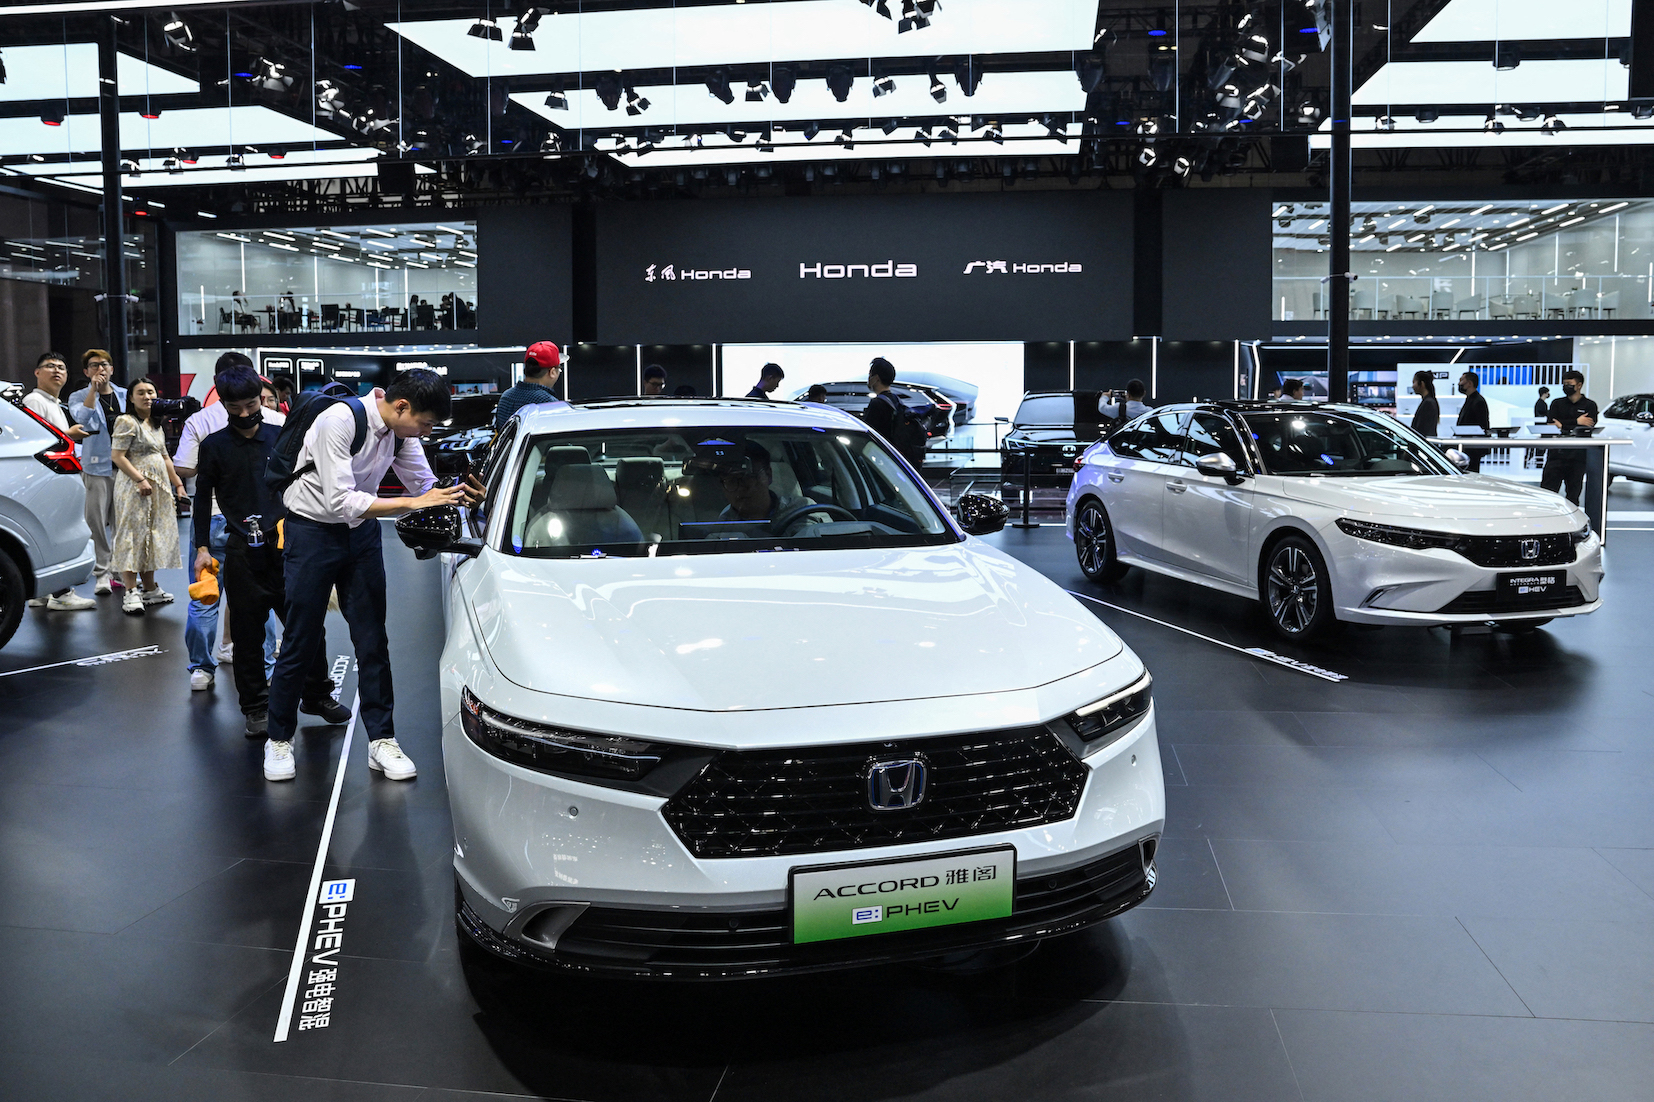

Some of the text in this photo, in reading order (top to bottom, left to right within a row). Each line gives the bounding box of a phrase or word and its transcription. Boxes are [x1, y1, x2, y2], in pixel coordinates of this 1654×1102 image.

[681, 267, 751, 280] Honda
[799, 259, 918, 279] Honda
[963, 260, 1082, 274] 广汽 Honda
[813, 865, 997, 900] ACCORD 雅阁
[298, 967, 338, 1031] 强电智混
